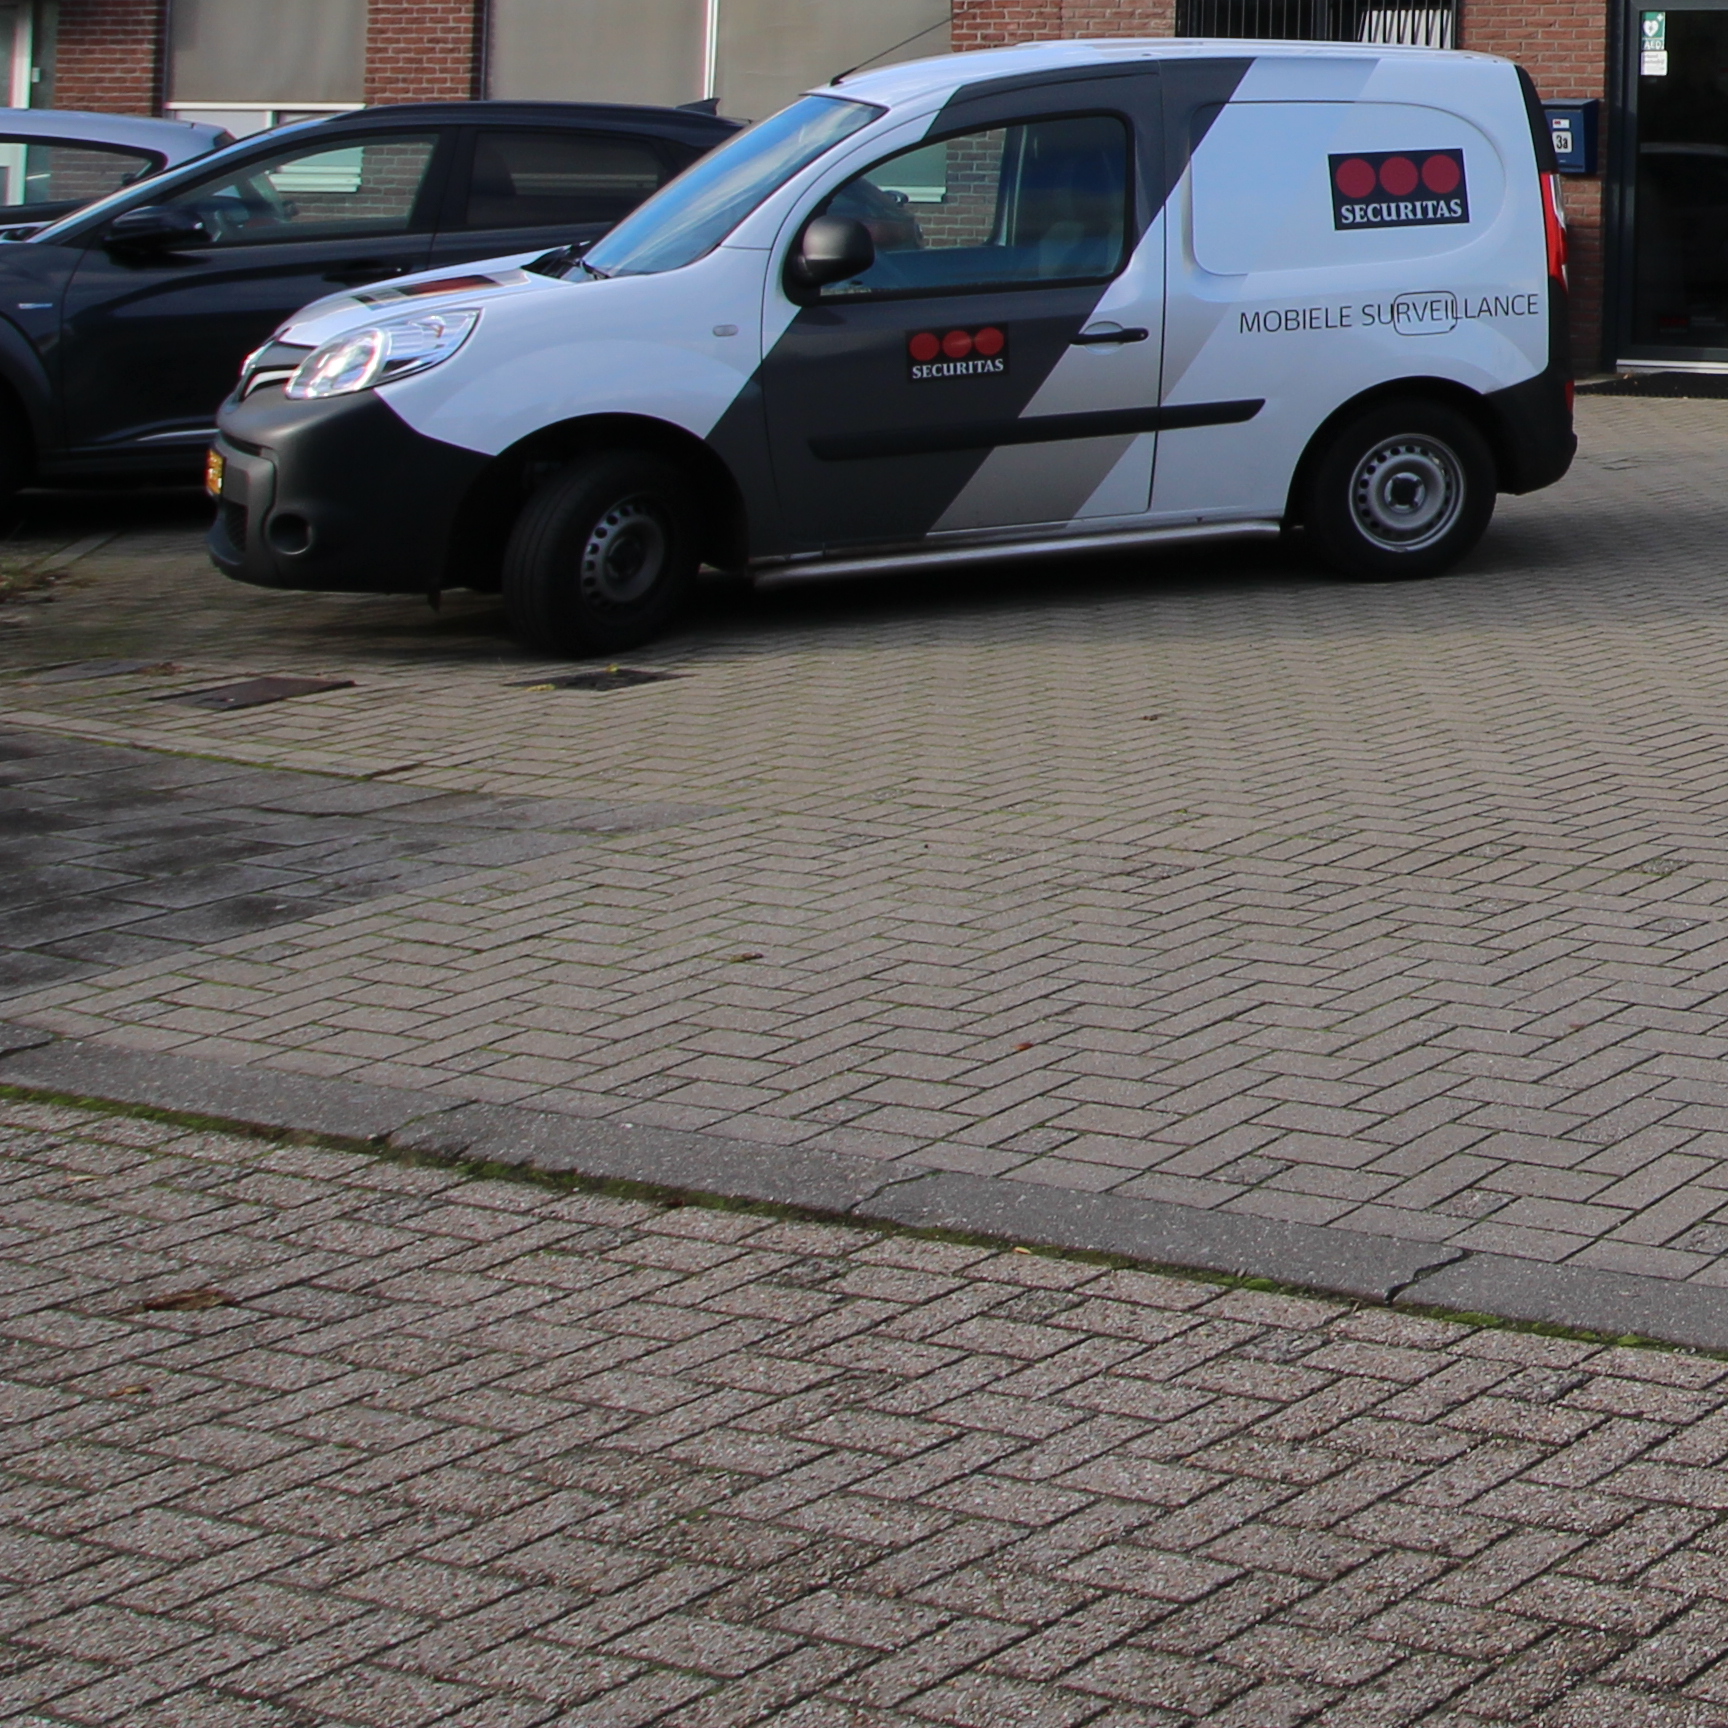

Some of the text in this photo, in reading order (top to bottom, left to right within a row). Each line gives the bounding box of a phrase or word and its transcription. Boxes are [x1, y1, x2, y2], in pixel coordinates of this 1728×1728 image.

[1556, 134, 1568, 149] 3a
[1341, 198, 1463, 223] SECURITAS
[1239, 293, 1540, 334] MOBIELE SURVEILLANCE
[912, 358, 1004, 379] SECURITAS
